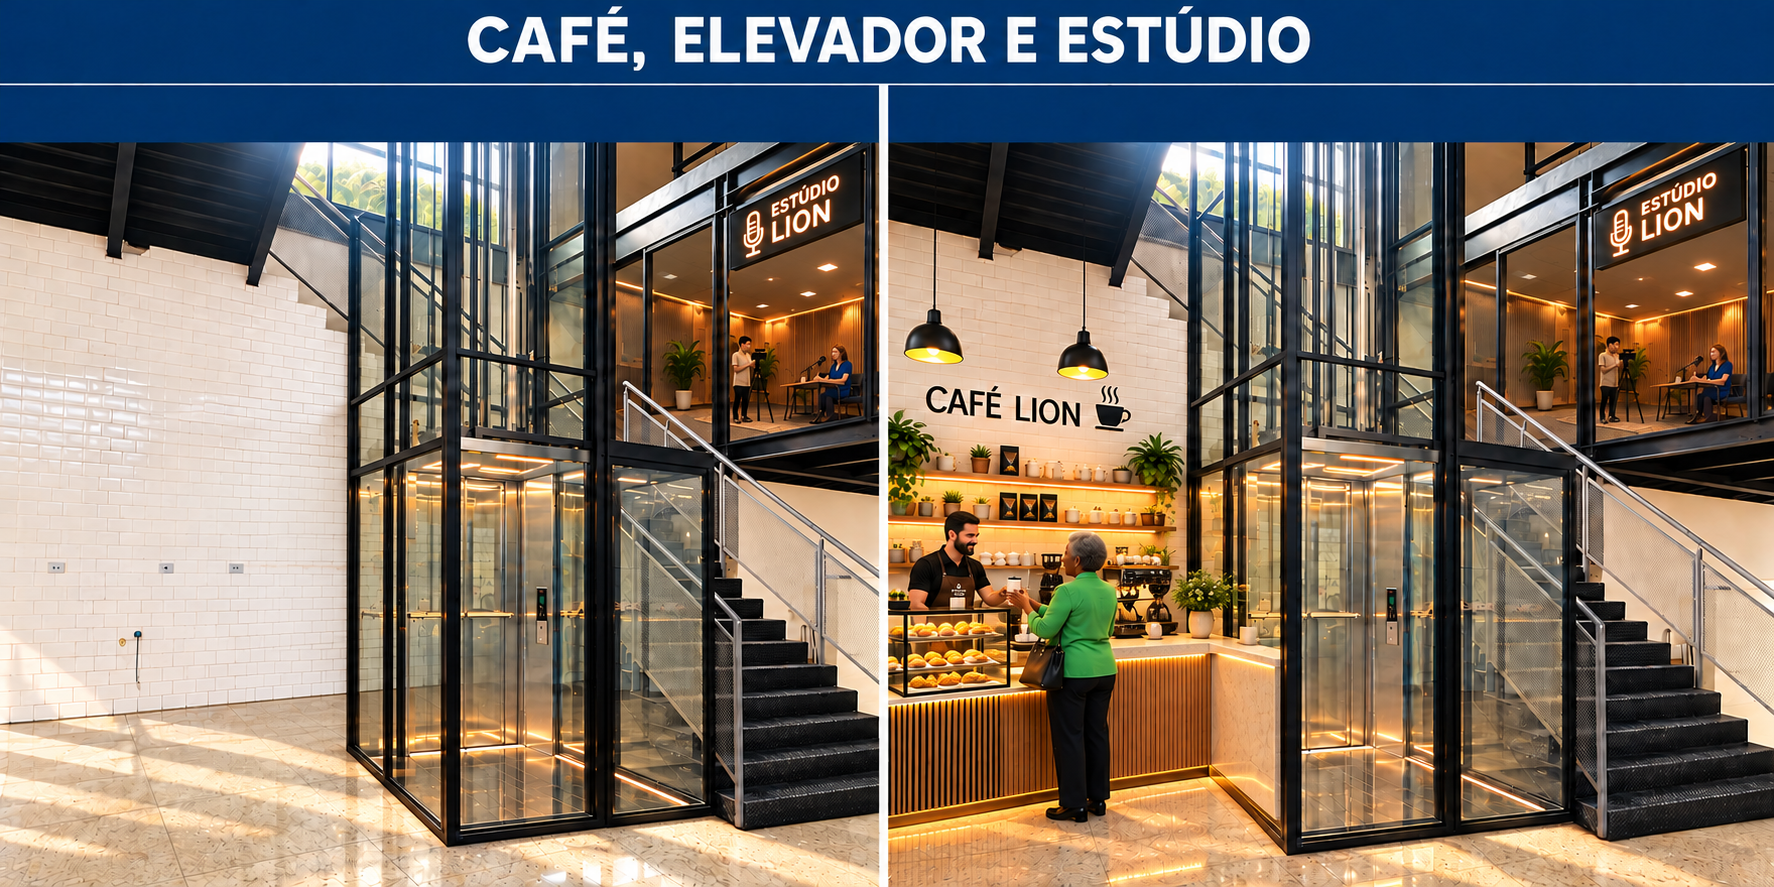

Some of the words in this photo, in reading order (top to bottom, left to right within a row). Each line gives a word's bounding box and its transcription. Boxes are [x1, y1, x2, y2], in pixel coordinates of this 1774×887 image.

[771, 174, 840, 218] ESTÚDIO
[1641, 172, 1717, 216] ESTÚDIO
[771, 198, 831, 244] LION
[1641, 196, 1704, 242] LION
[926, 385, 1001, 419] CAFÉ
[1015, 395, 1080, 427] LION
